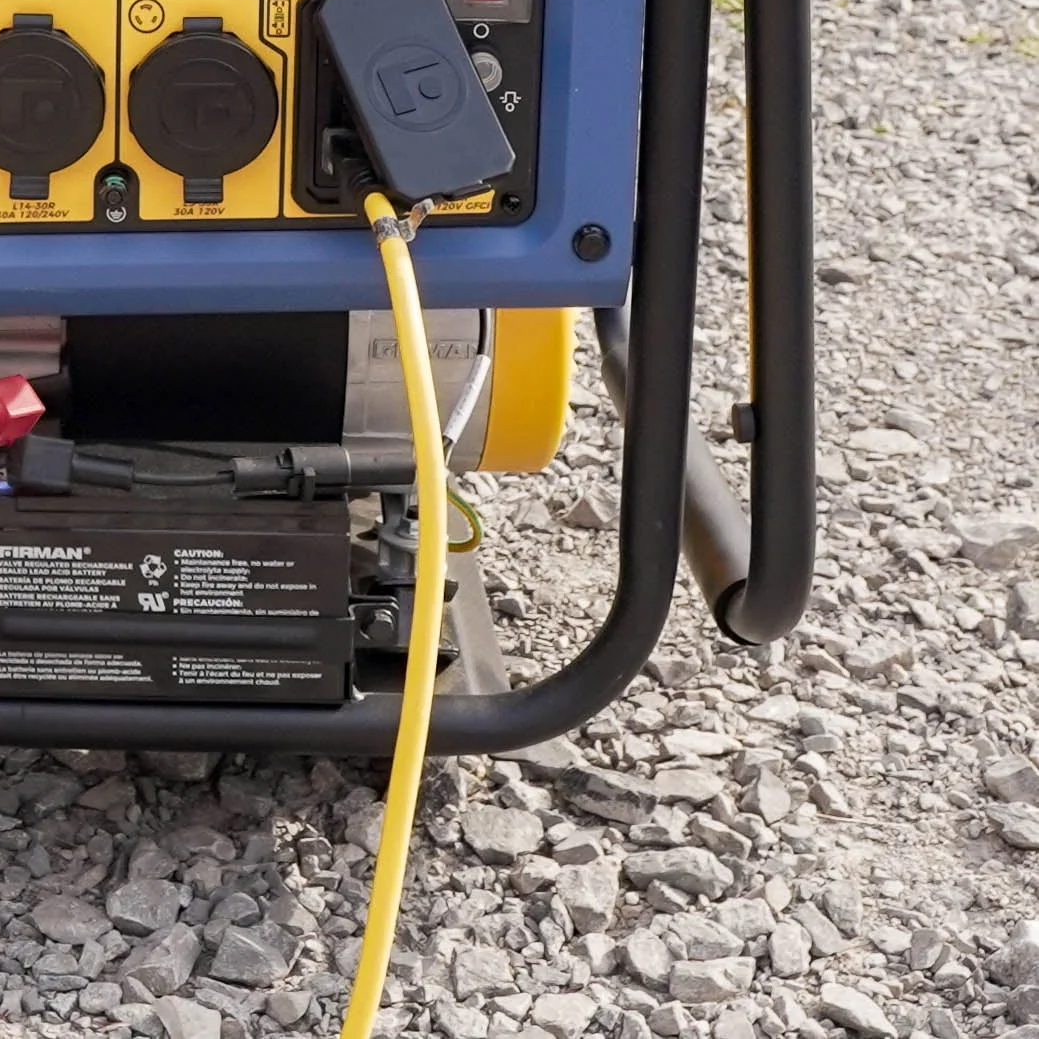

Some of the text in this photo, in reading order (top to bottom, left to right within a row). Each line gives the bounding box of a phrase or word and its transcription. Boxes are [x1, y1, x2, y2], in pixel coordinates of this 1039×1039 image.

[13, 202, 56, 210] L14-30R
[465, 202, 490, 210] GFCI
[20, 210, 70, 219] 120/240V
[172, 208, 225, 216] 30A 120V
[174, 550, 224, 558] CAUTION:
[24, 561, 70, 569] REGULATED
[72, 562, 133, 570] RECHARGEABLE
[180, 567, 222, 575] electrolyte
[59, 585, 100, 593] VÁLVULAS
[180, 582, 201, 590] Keep
[173, 598, 244, 607] PRECAUCIÓN:
